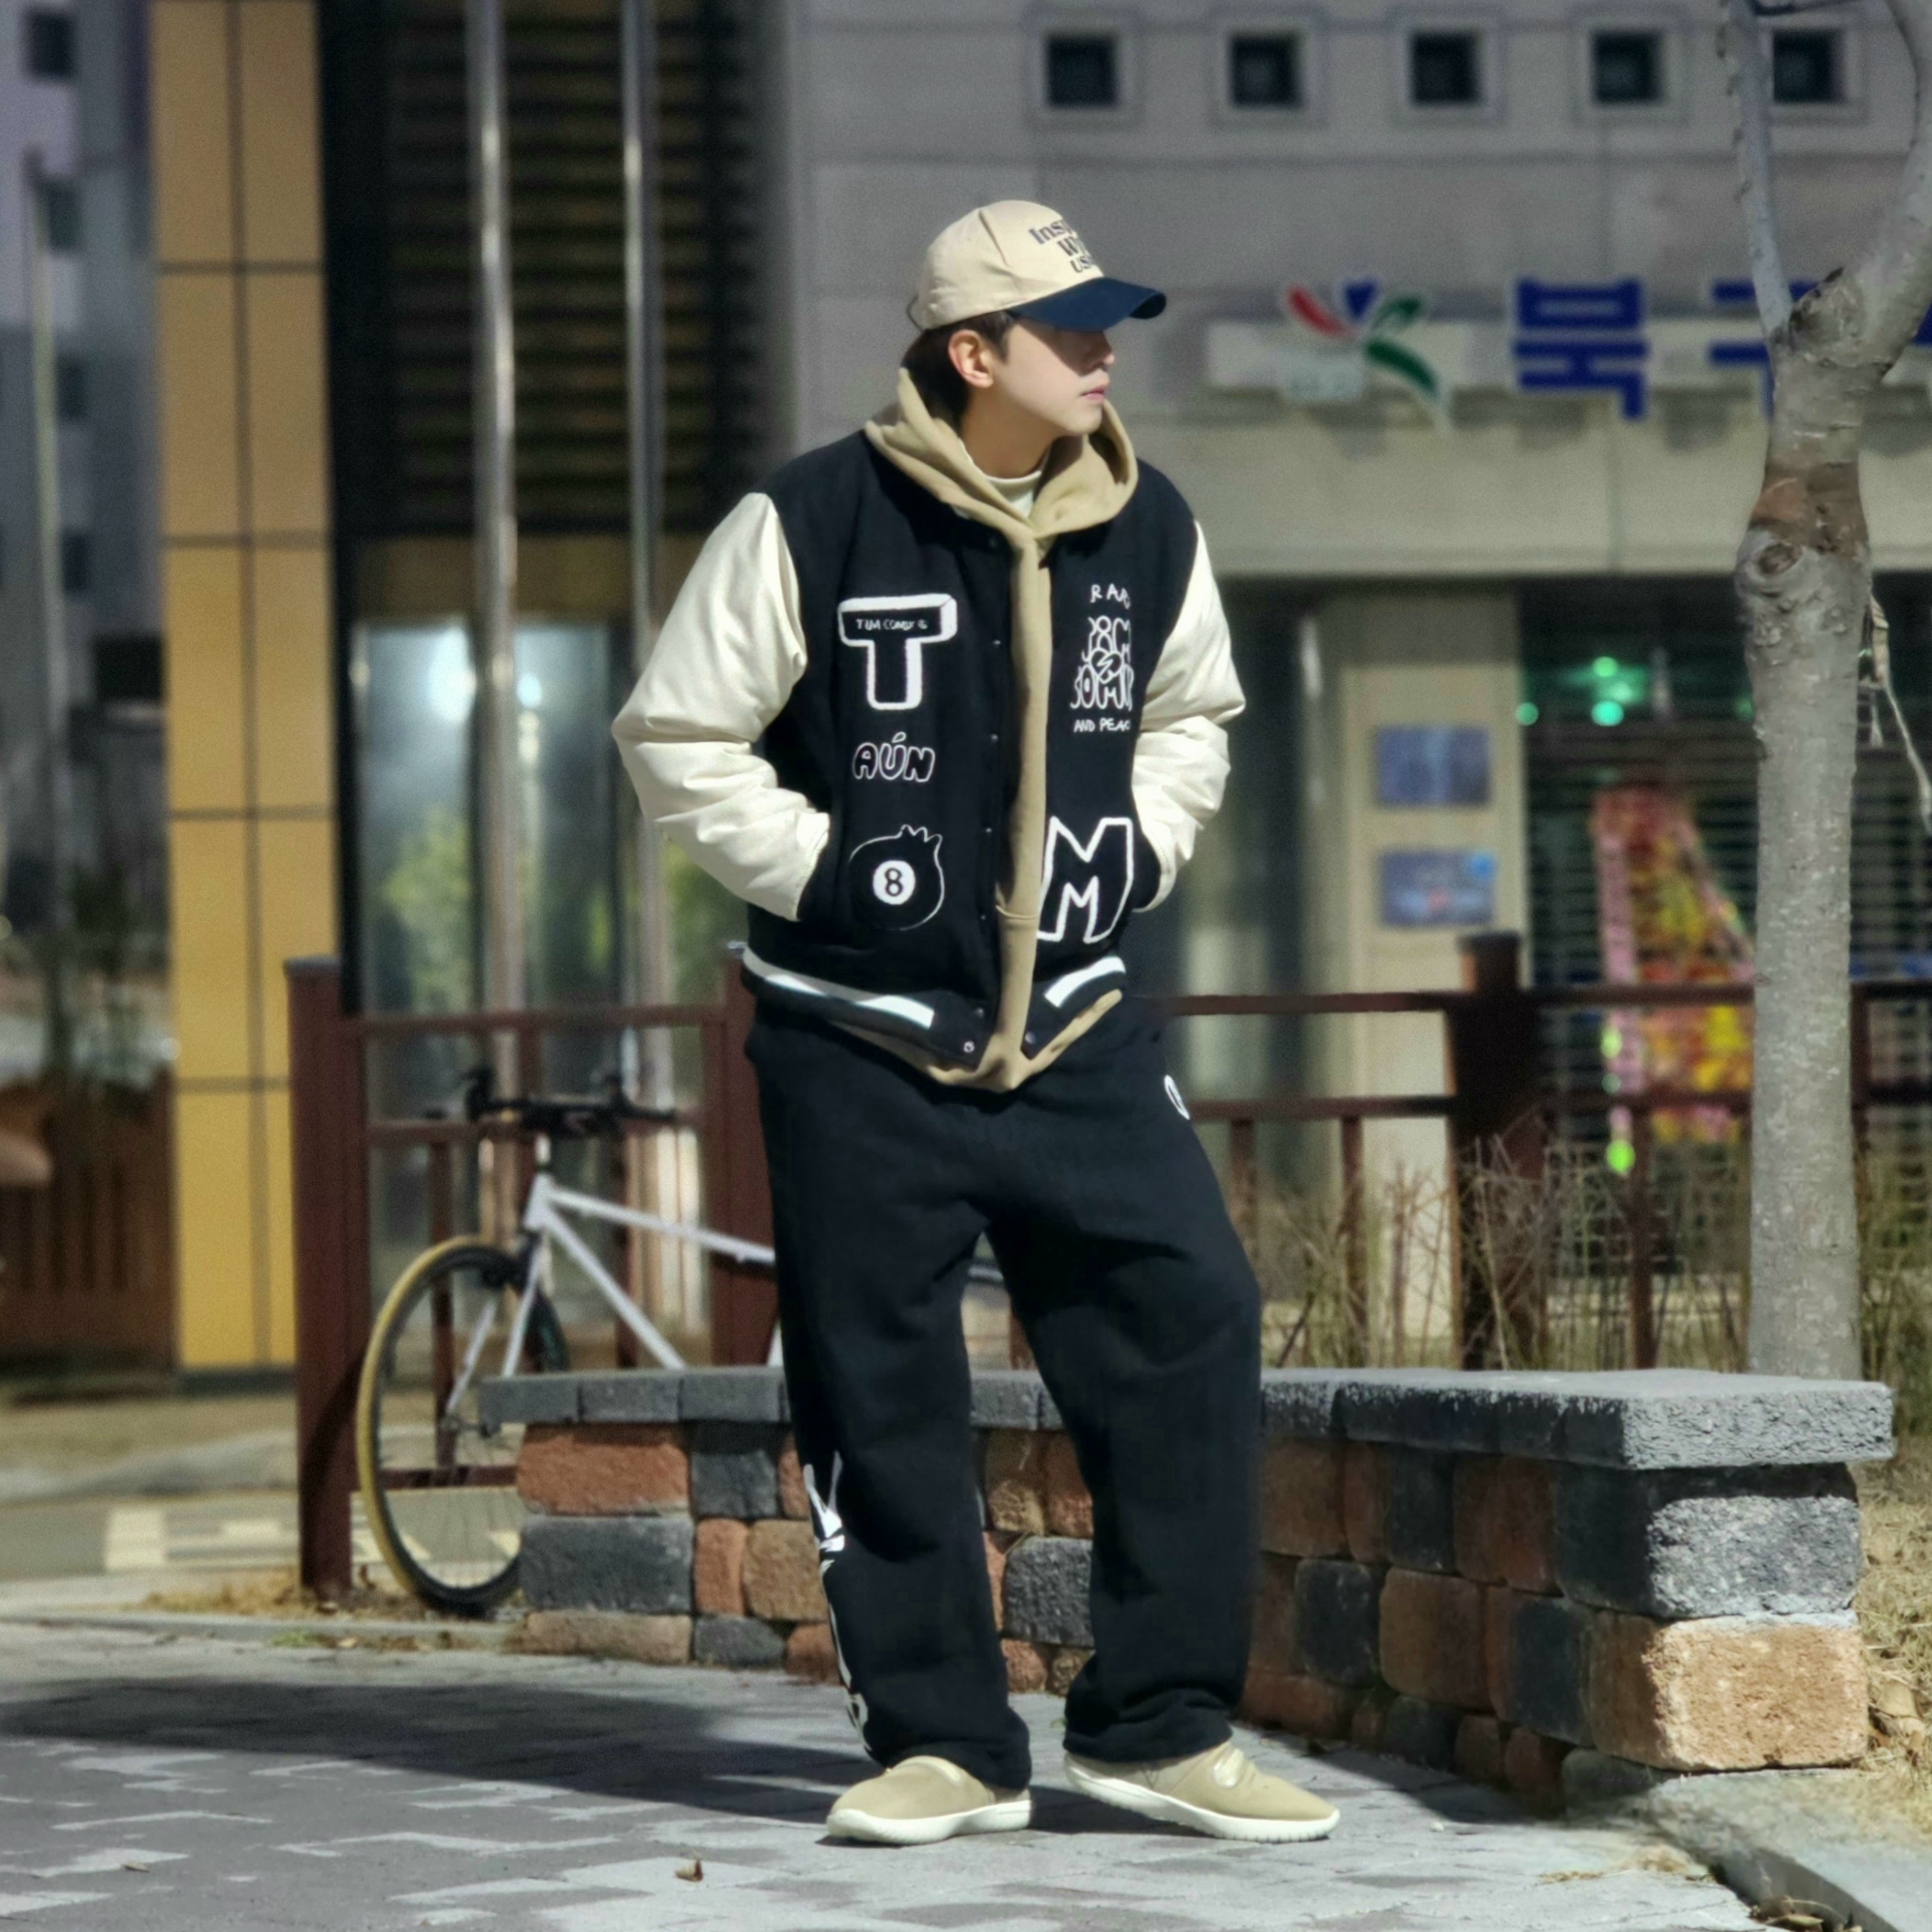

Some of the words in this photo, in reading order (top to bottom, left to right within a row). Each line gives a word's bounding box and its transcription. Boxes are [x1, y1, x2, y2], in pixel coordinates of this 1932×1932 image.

[1074, 718, 1095, 733] AND
[1100, 717, 1131, 732] PEAC
[852, 731, 935, 782] AÚN
[883, 867, 903, 898] 8
[1036, 815, 1134, 944] M
